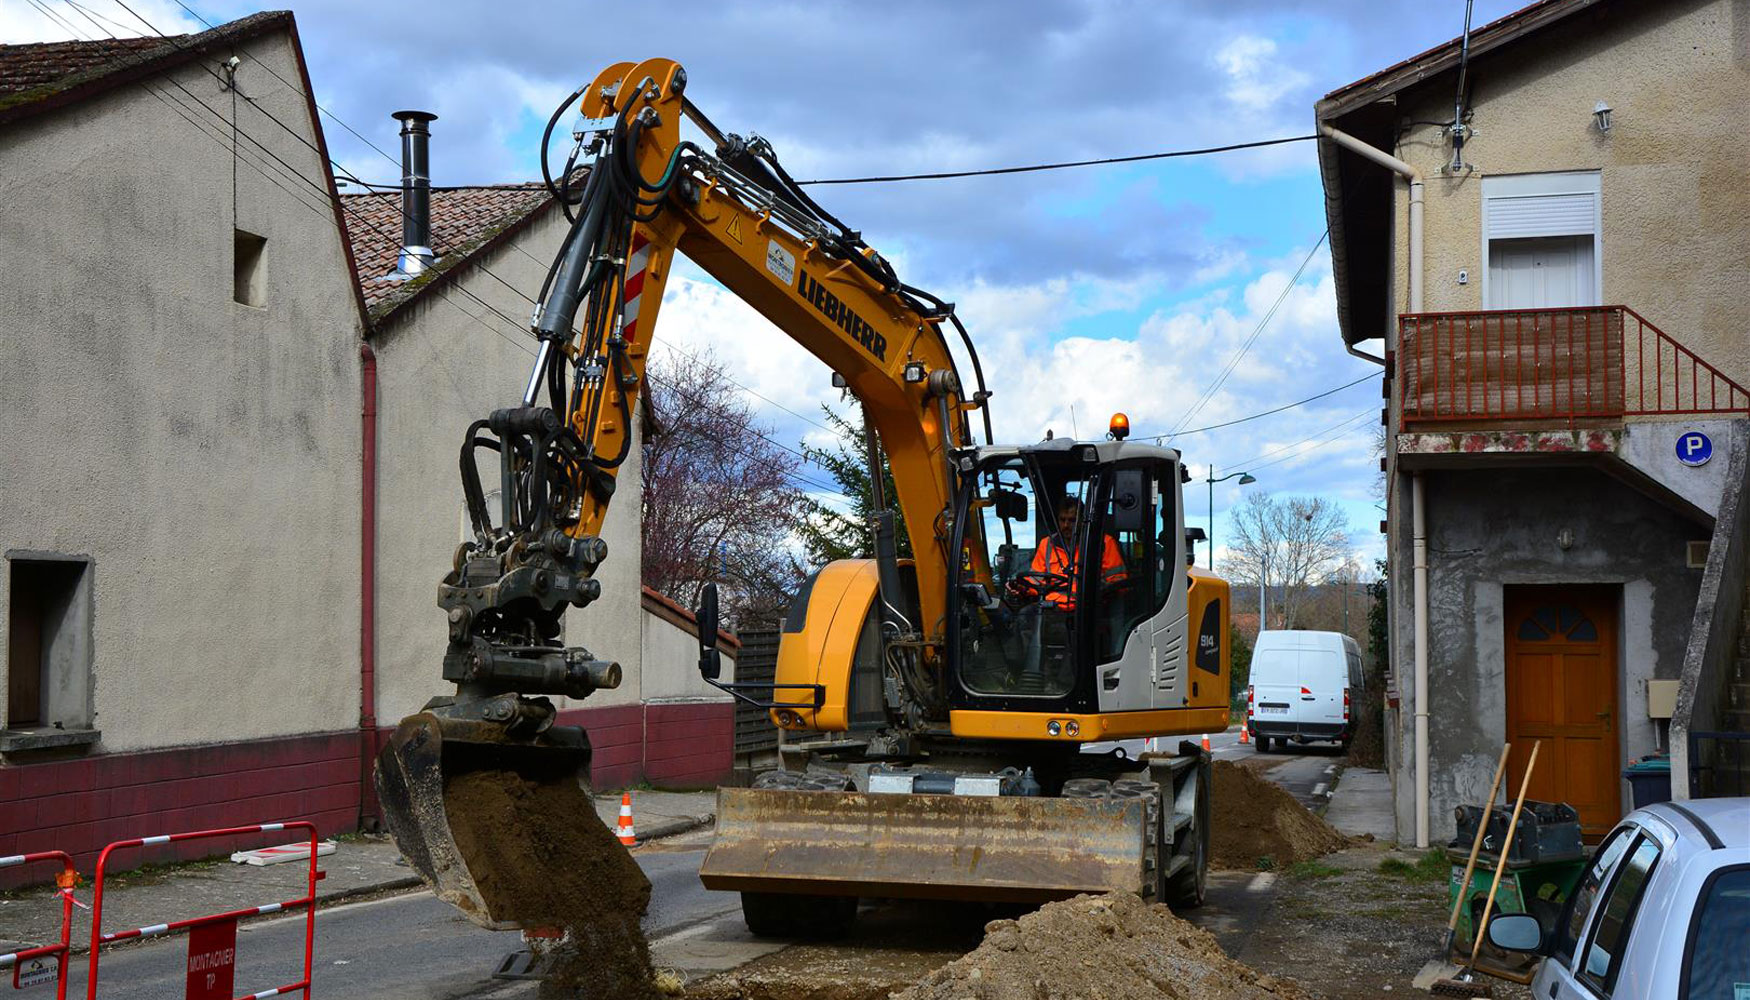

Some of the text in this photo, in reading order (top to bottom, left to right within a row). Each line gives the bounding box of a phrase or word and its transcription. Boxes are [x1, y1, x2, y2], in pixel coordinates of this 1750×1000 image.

[798, 269, 887, 362] LIEBHERR
[1686, 436, 1703, 455] P
[1200, 635, 1214, 647] 914
[189, 948, 234, 972] MONTAGNIER
[206, 973, 216, 990] TP
